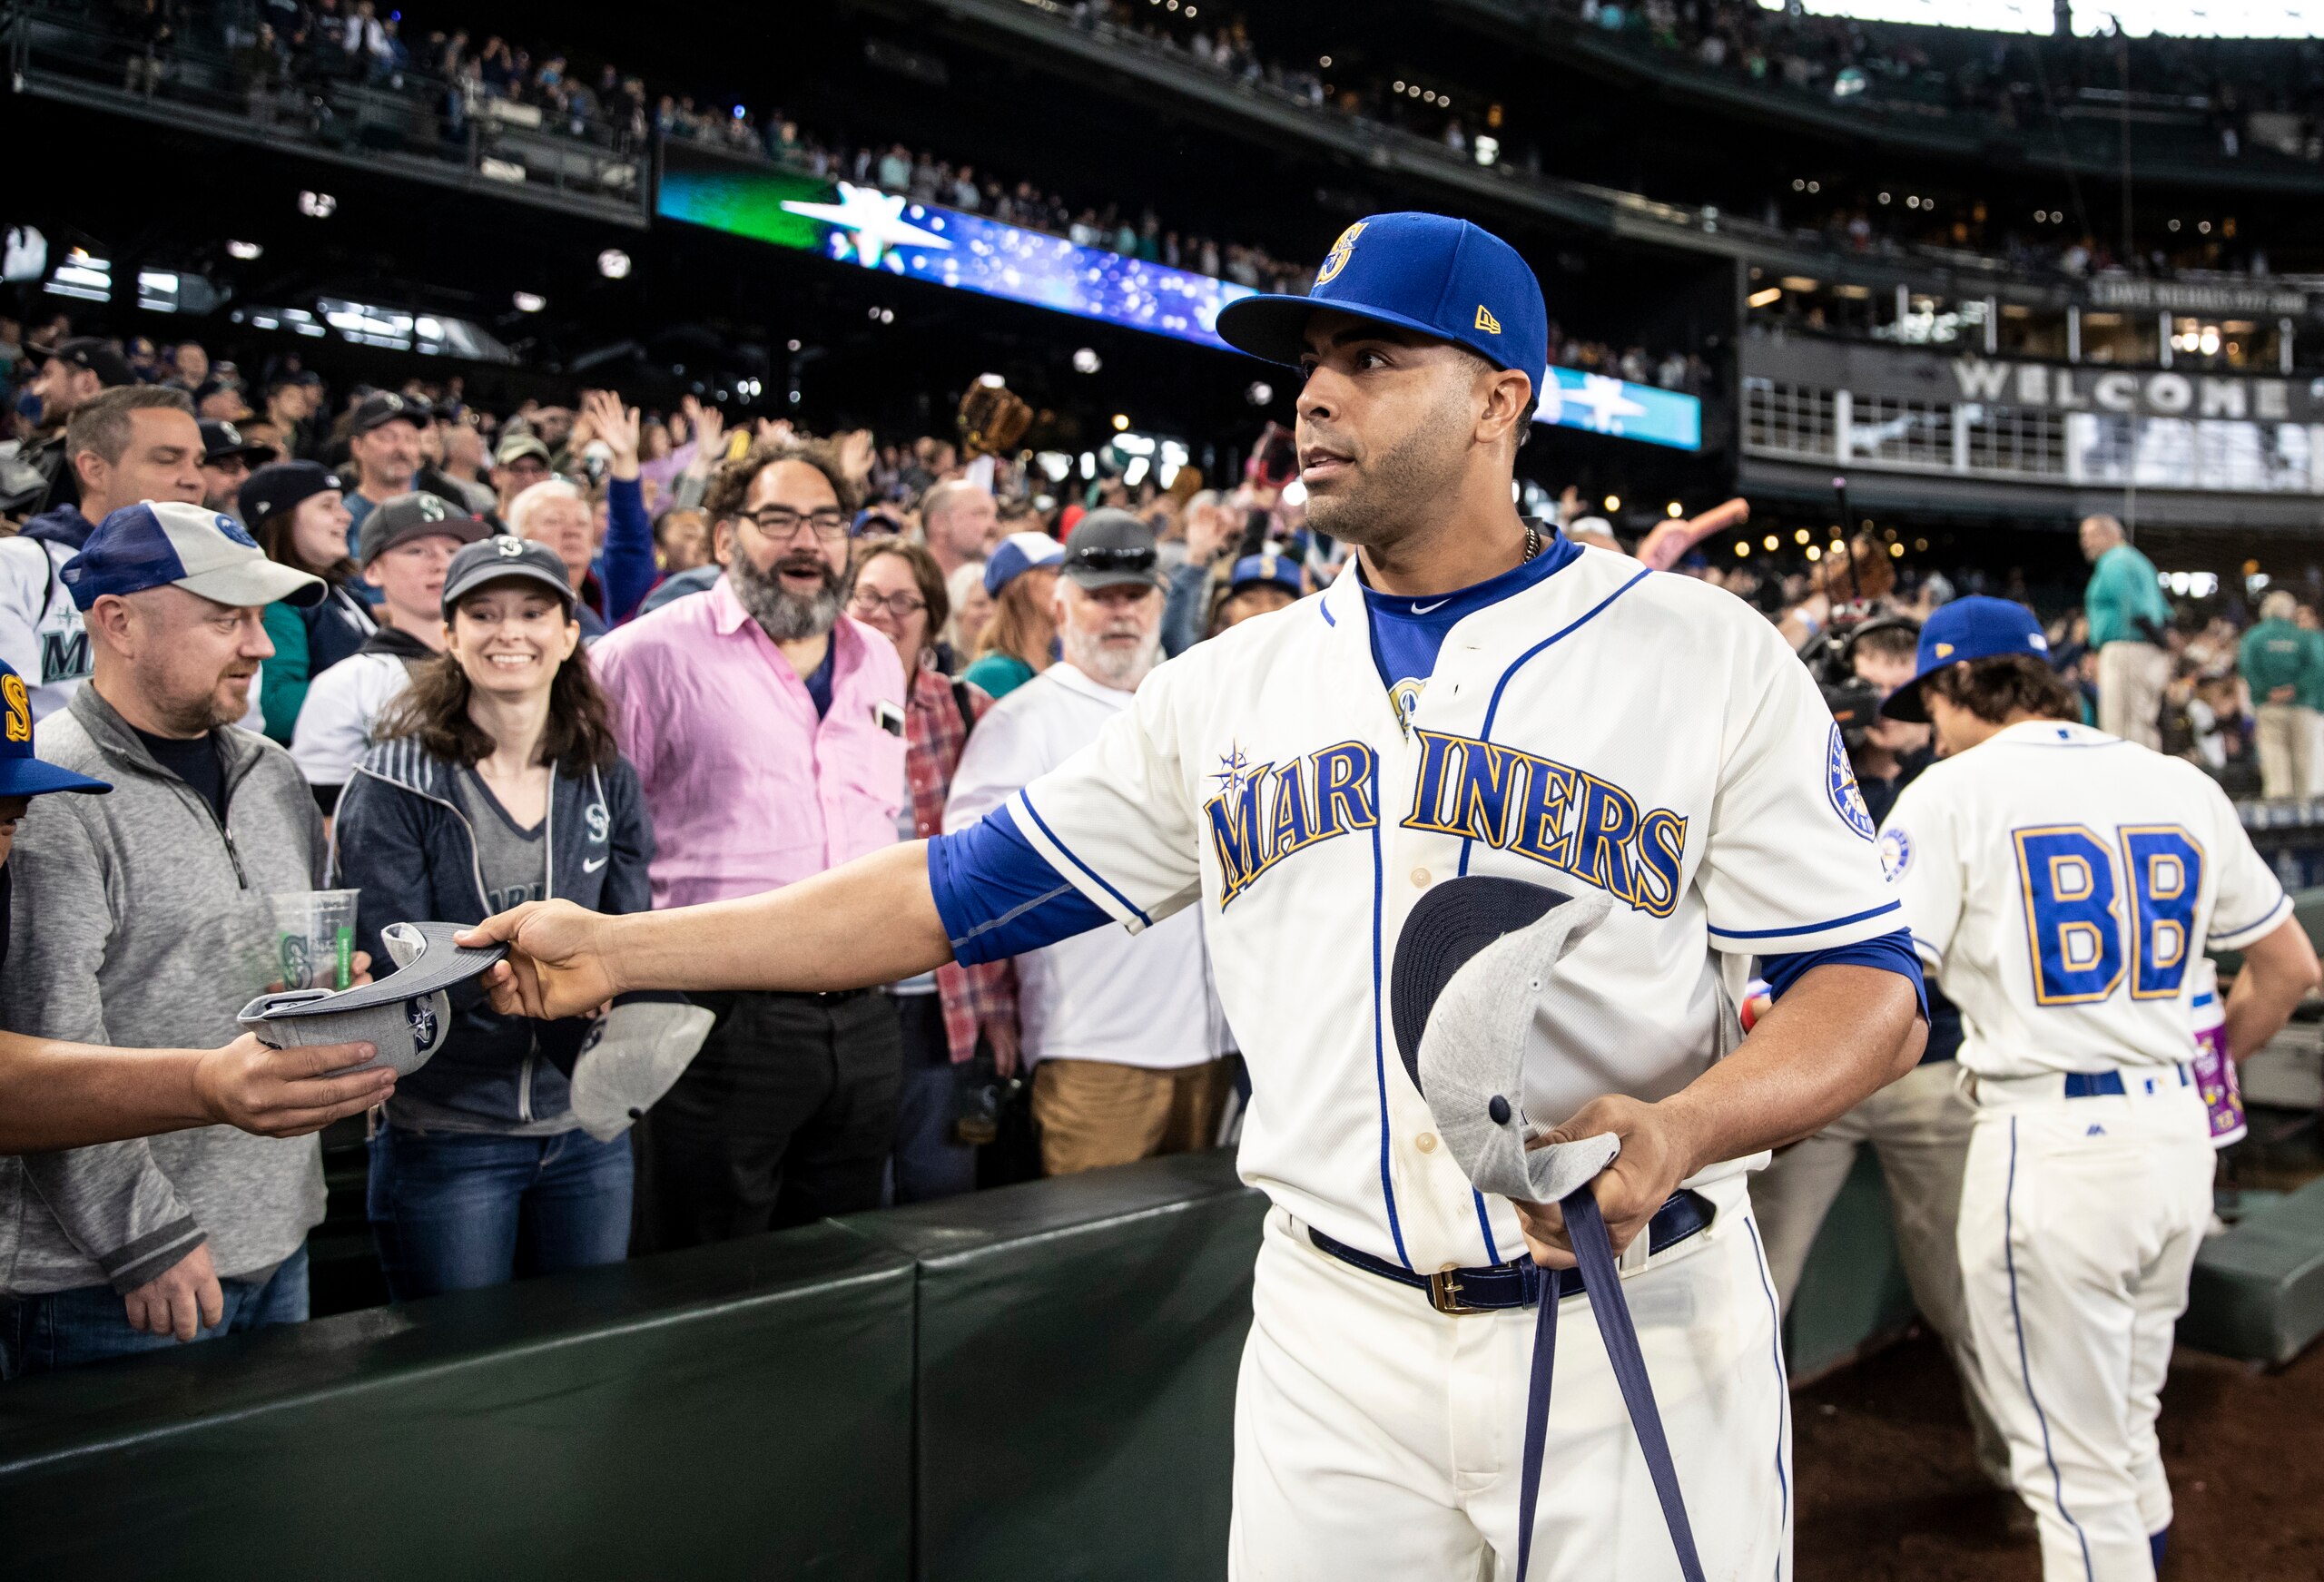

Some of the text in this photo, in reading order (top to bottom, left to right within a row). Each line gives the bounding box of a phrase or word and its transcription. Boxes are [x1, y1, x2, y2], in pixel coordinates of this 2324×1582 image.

[1314, 221, 1370, 288] S
[1952, 361, 2290, 419] WELCOME
[498, 535, 523, 557] S
[1, 673, 31, 742] S
[585, 802, 611, 844] S
[1202, 726, 1689, 919] MARINERS
[2011, 822, 2207, 1007] BB
